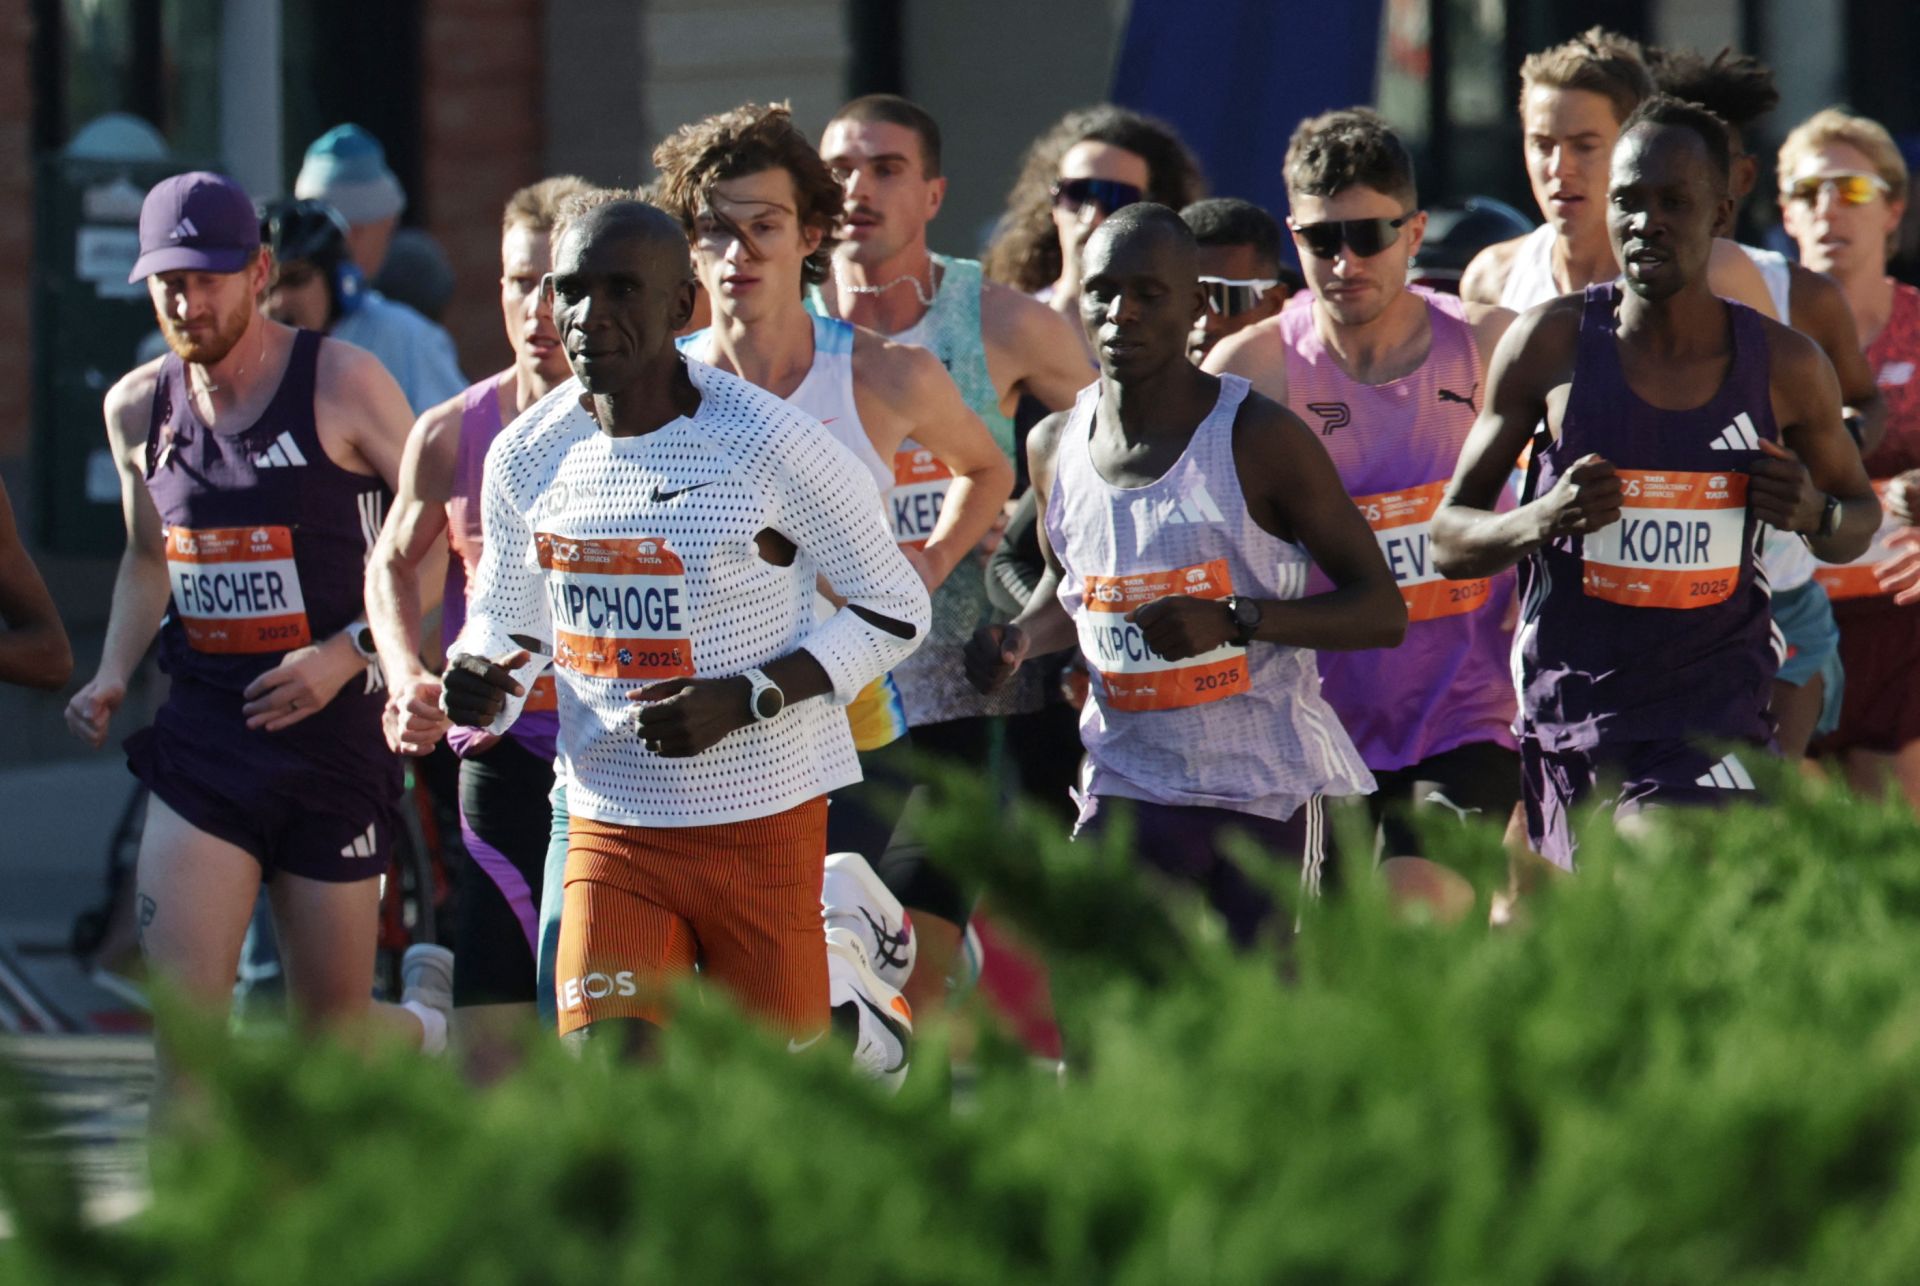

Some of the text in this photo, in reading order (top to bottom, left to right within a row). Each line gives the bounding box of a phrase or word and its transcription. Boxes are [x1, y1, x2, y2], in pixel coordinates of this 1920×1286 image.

[1705, 491, 1729, 499] TATA
[250, 544, 273, 553] TATA
[1620, 518, 1711, 564] KORIR
[180, 571, 288, 614] FISCHER
[1184, 582, 1212, 595] TATA
[1690, 580, 1729, 597] 2025
[549, 581, 682, 632] KIPCHOGE
[258, 624, 300, 641] 2025
[638, 650, 682, 667] 2025
[1194, 669, 1240, 692] 2025
